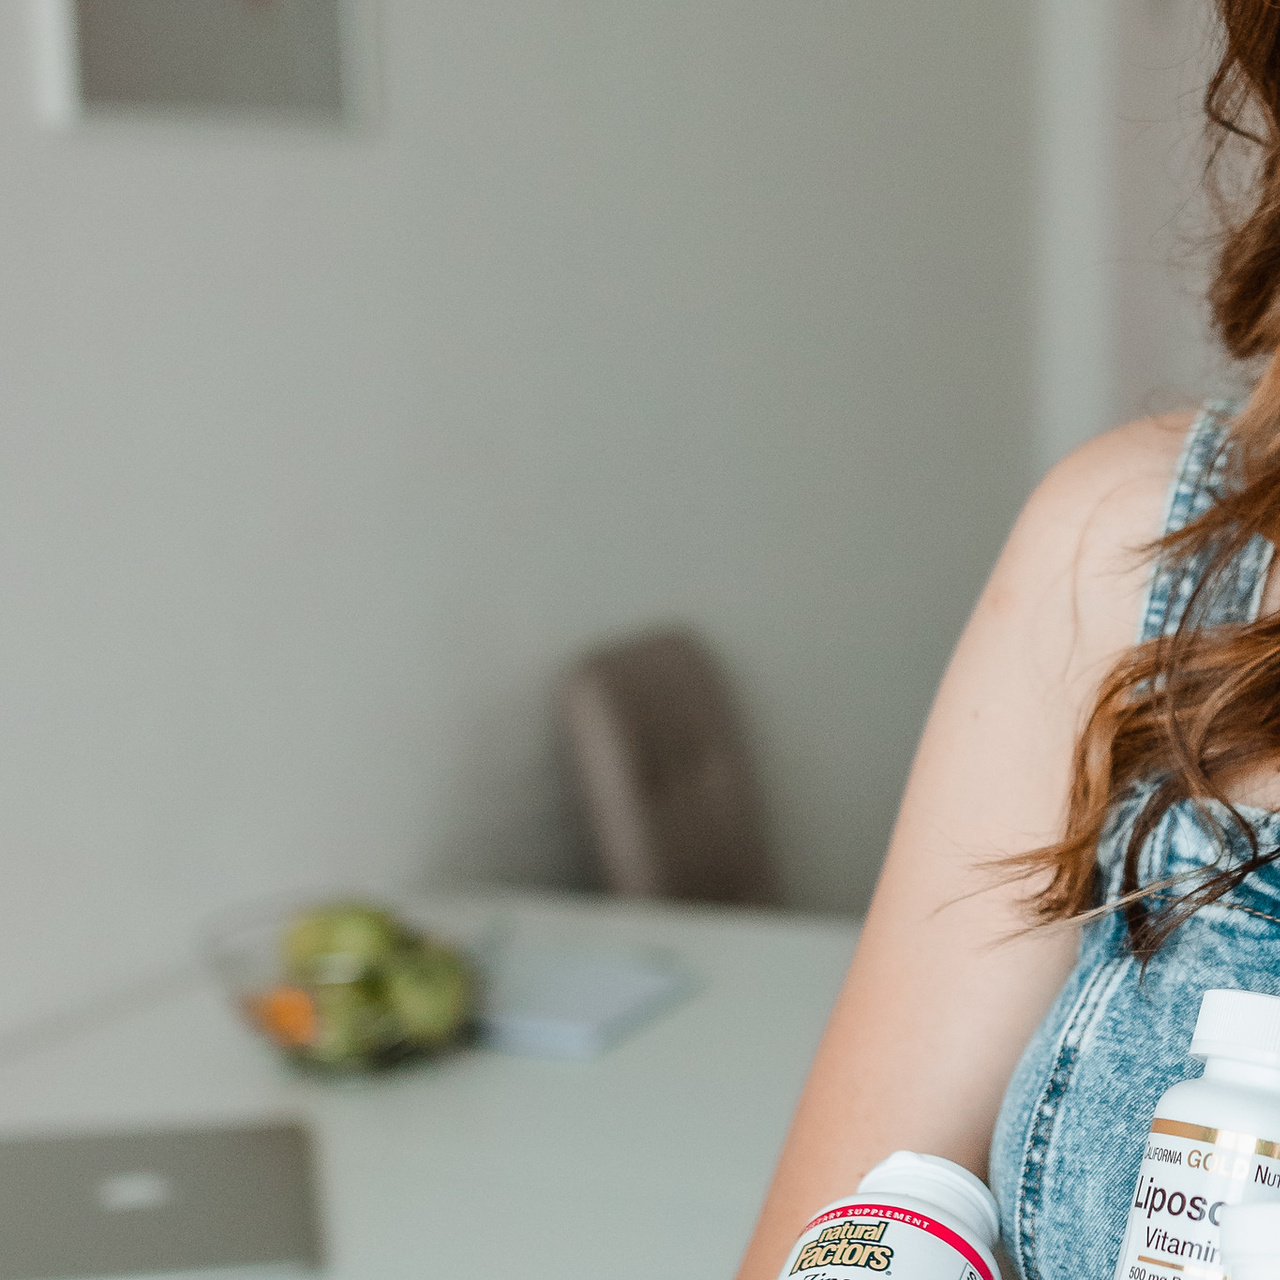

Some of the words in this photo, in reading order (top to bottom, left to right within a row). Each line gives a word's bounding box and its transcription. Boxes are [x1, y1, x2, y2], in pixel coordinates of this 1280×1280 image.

[846, 1207, 930, 1230] SUPPLEMENT
[816, 1220, 889, 1244] natural
[788, 1239, 895, 1277] Factors
